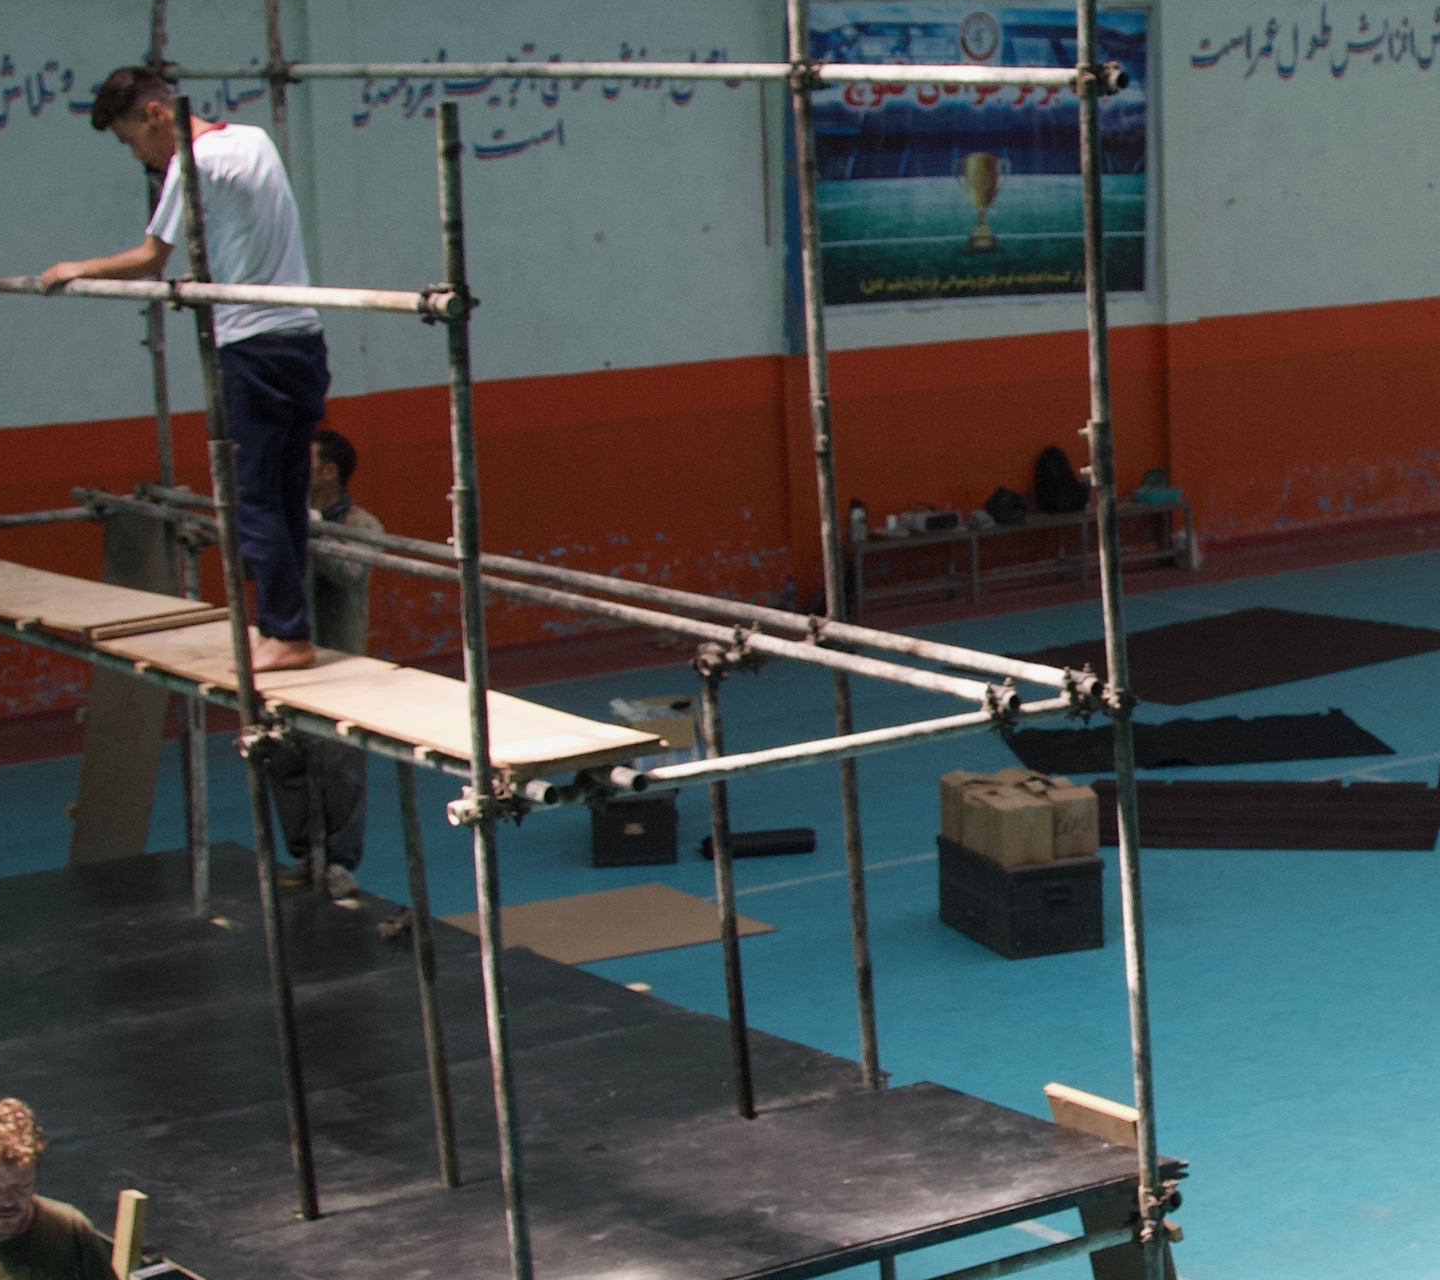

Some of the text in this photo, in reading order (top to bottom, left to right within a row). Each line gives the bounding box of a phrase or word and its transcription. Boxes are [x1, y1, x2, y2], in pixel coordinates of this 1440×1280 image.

[1191, 26, 1253, 68] است
[1244, 17, 1277, 79] عمر
[1277, 4, 1331, 79] طول
[61, 68, 74, 93] و
[473, 120, 565, 160] است
